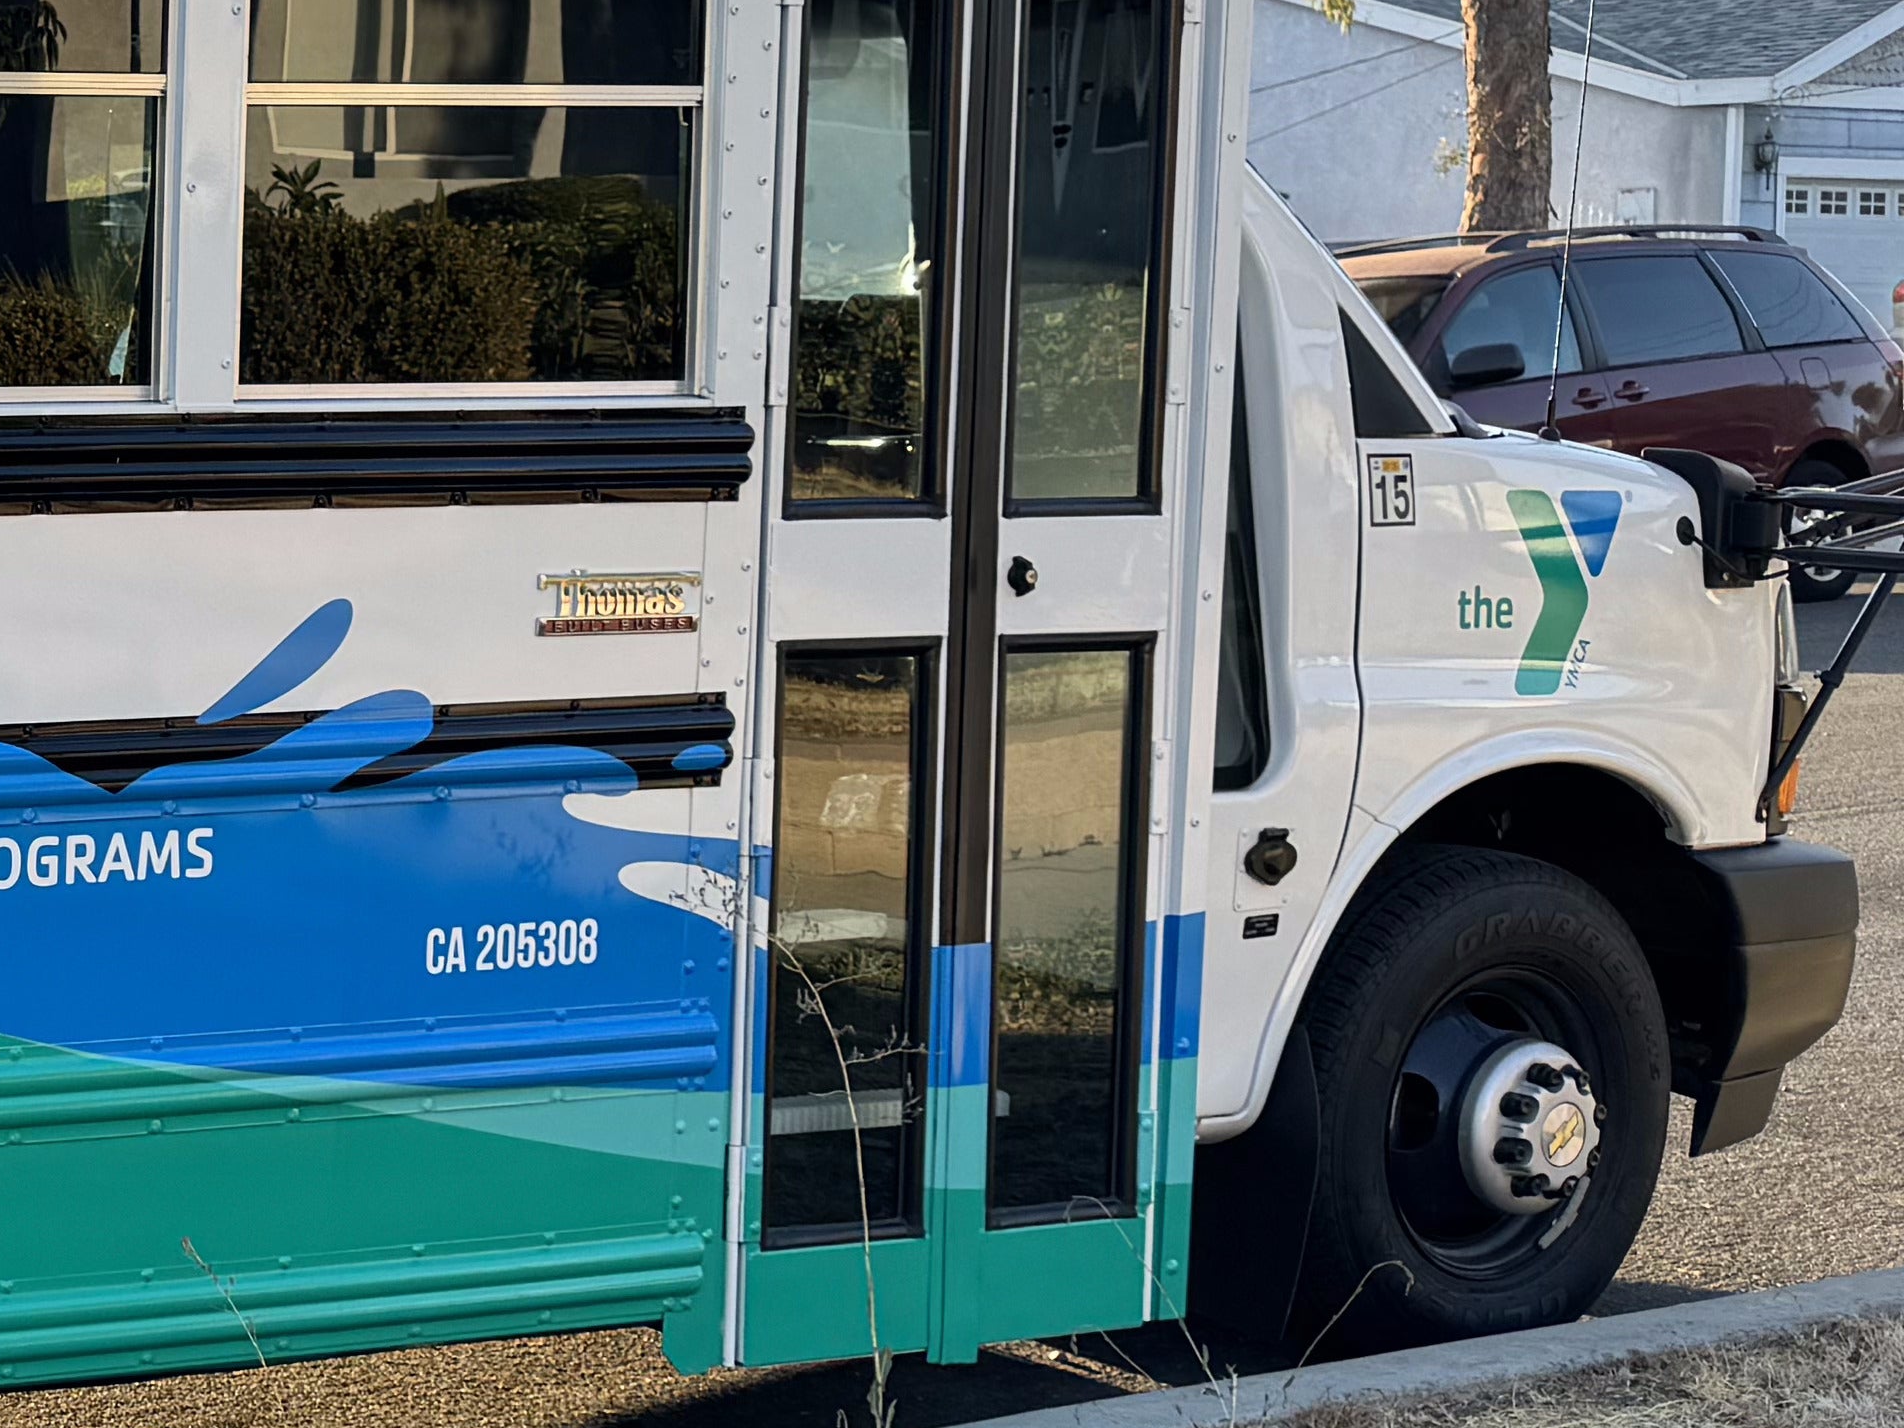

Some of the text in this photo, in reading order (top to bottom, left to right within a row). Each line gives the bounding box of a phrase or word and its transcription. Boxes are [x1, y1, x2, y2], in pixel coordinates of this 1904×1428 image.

[1375, 474, 1411, 520] 15
[537, 569, 702, 616] Thomas
[1457, 584, 1513, 630] the
[554, 617, 687, 634] BUILT BUSES
[1564, 638, 1592, 690] YMCA
[426, 918, 598, 974] CA 205308
